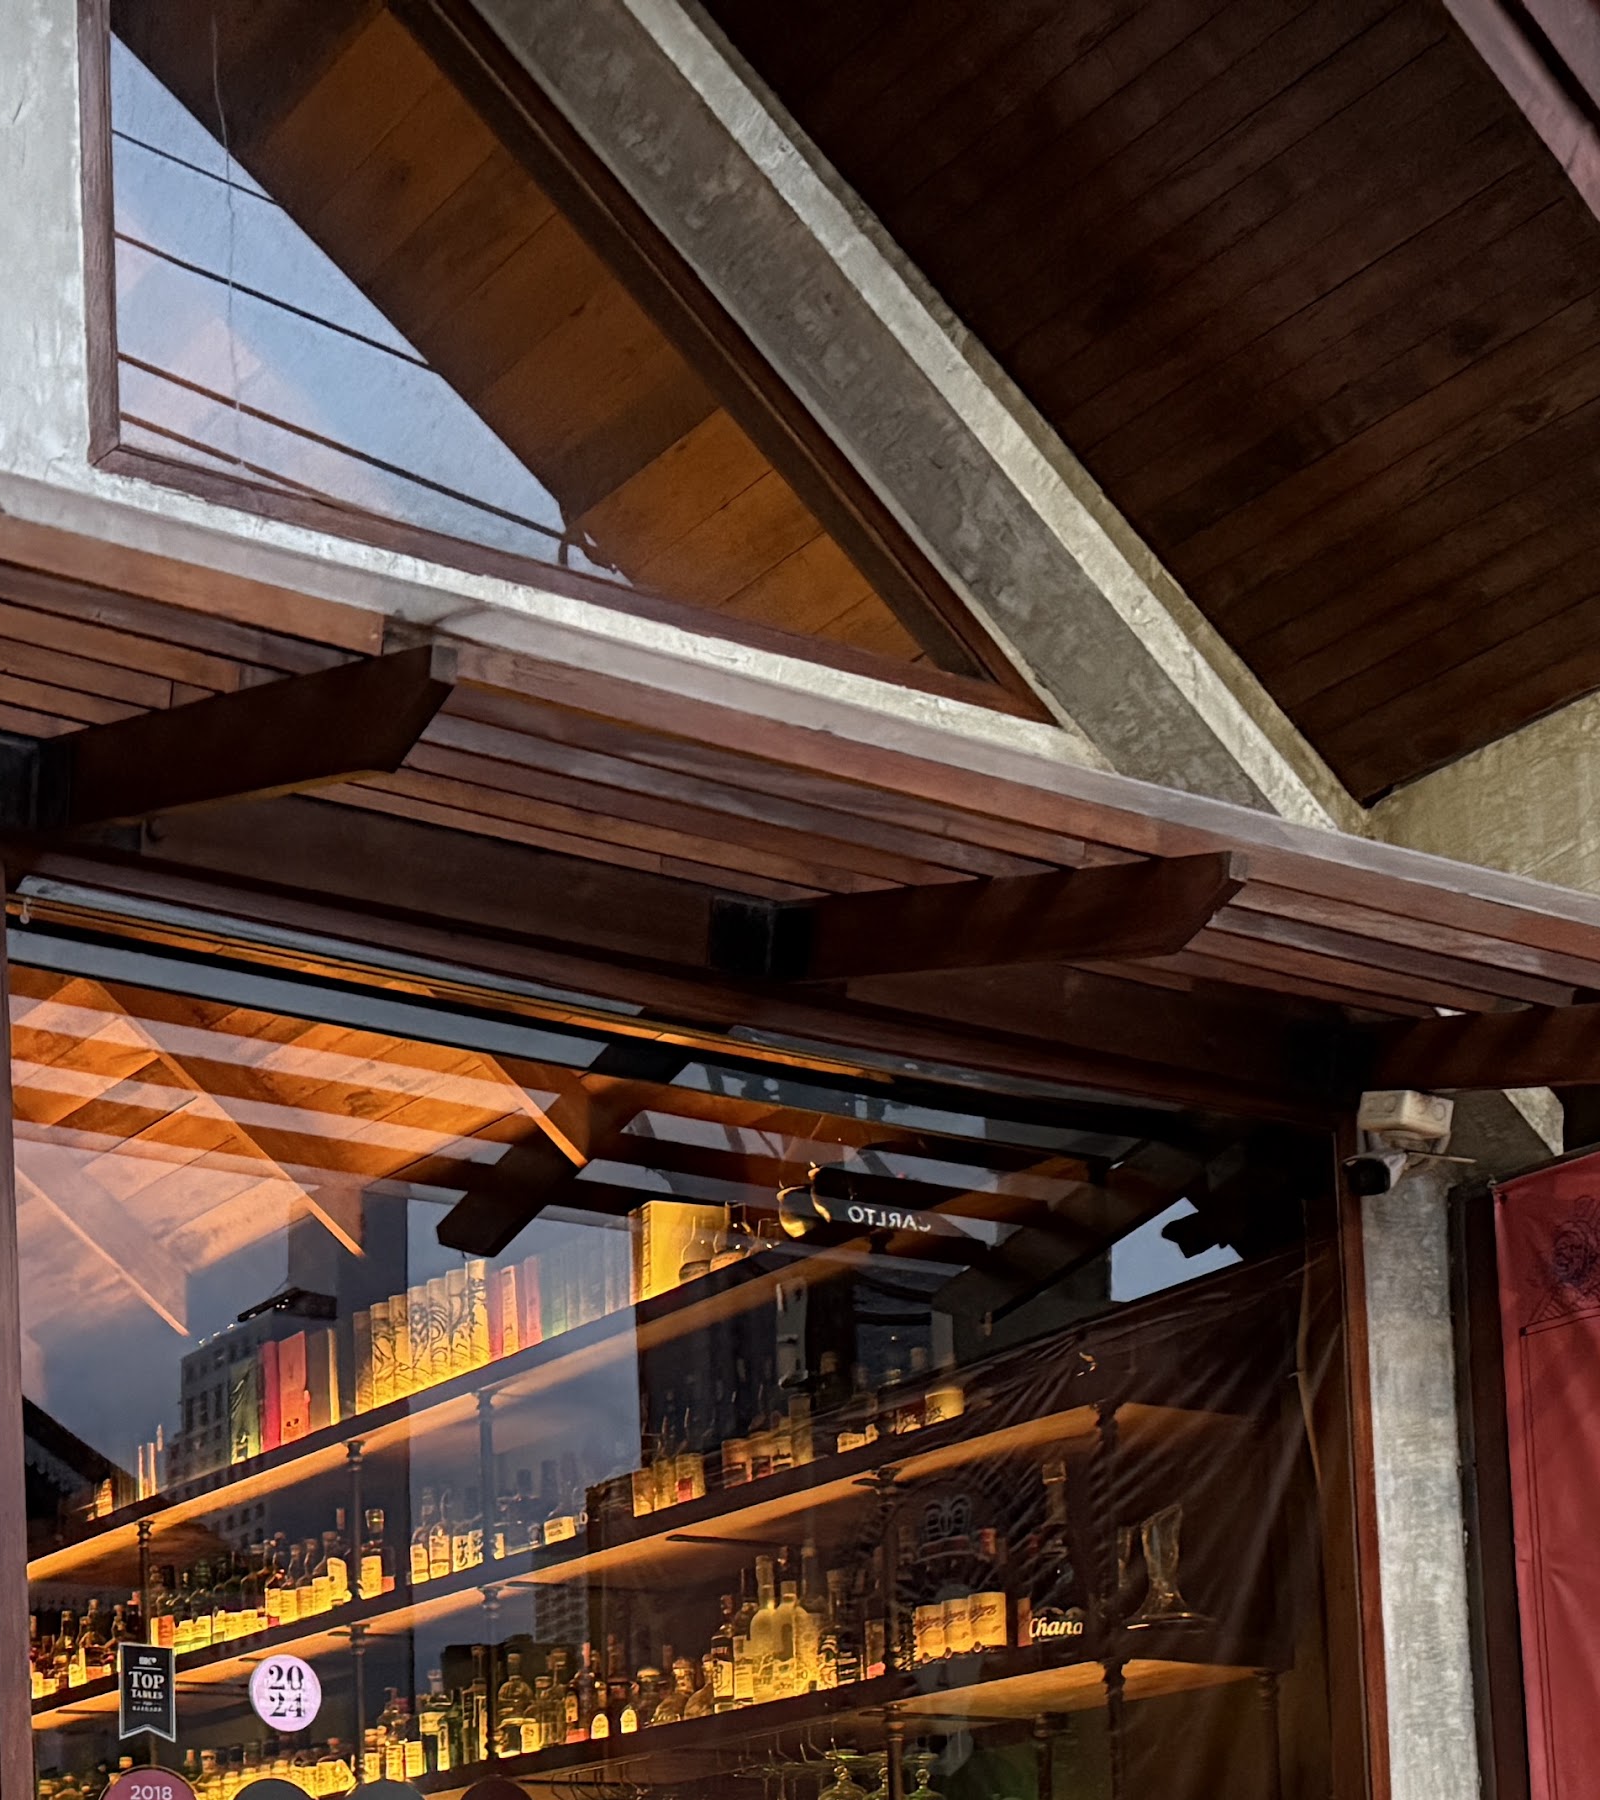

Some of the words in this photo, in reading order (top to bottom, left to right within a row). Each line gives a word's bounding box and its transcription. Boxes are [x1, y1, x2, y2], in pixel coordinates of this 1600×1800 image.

[128, 1671, 165, 1689] TOP
[268, 1664, 305, 1691] 20
[269, 1691, 307, 1718] 24
[130, 1785, 174, 1800] 2018
